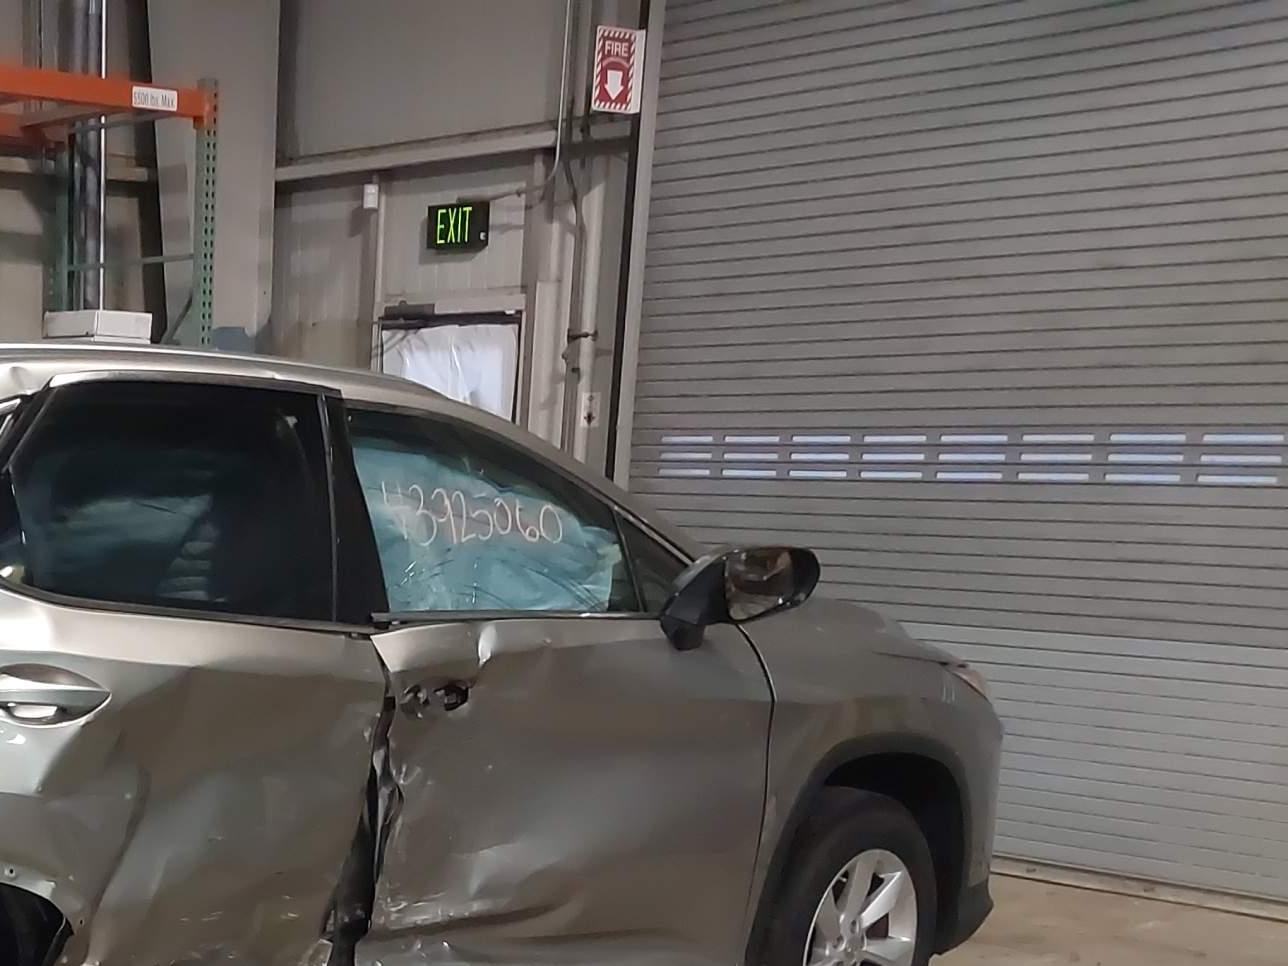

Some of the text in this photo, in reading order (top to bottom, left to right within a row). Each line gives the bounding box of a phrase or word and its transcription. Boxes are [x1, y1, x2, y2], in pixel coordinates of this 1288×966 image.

[604, 40, 629, 57] FIRE
[436, 206, 473, 244] EXIT
[381, 480, 563, 547] 43925060
